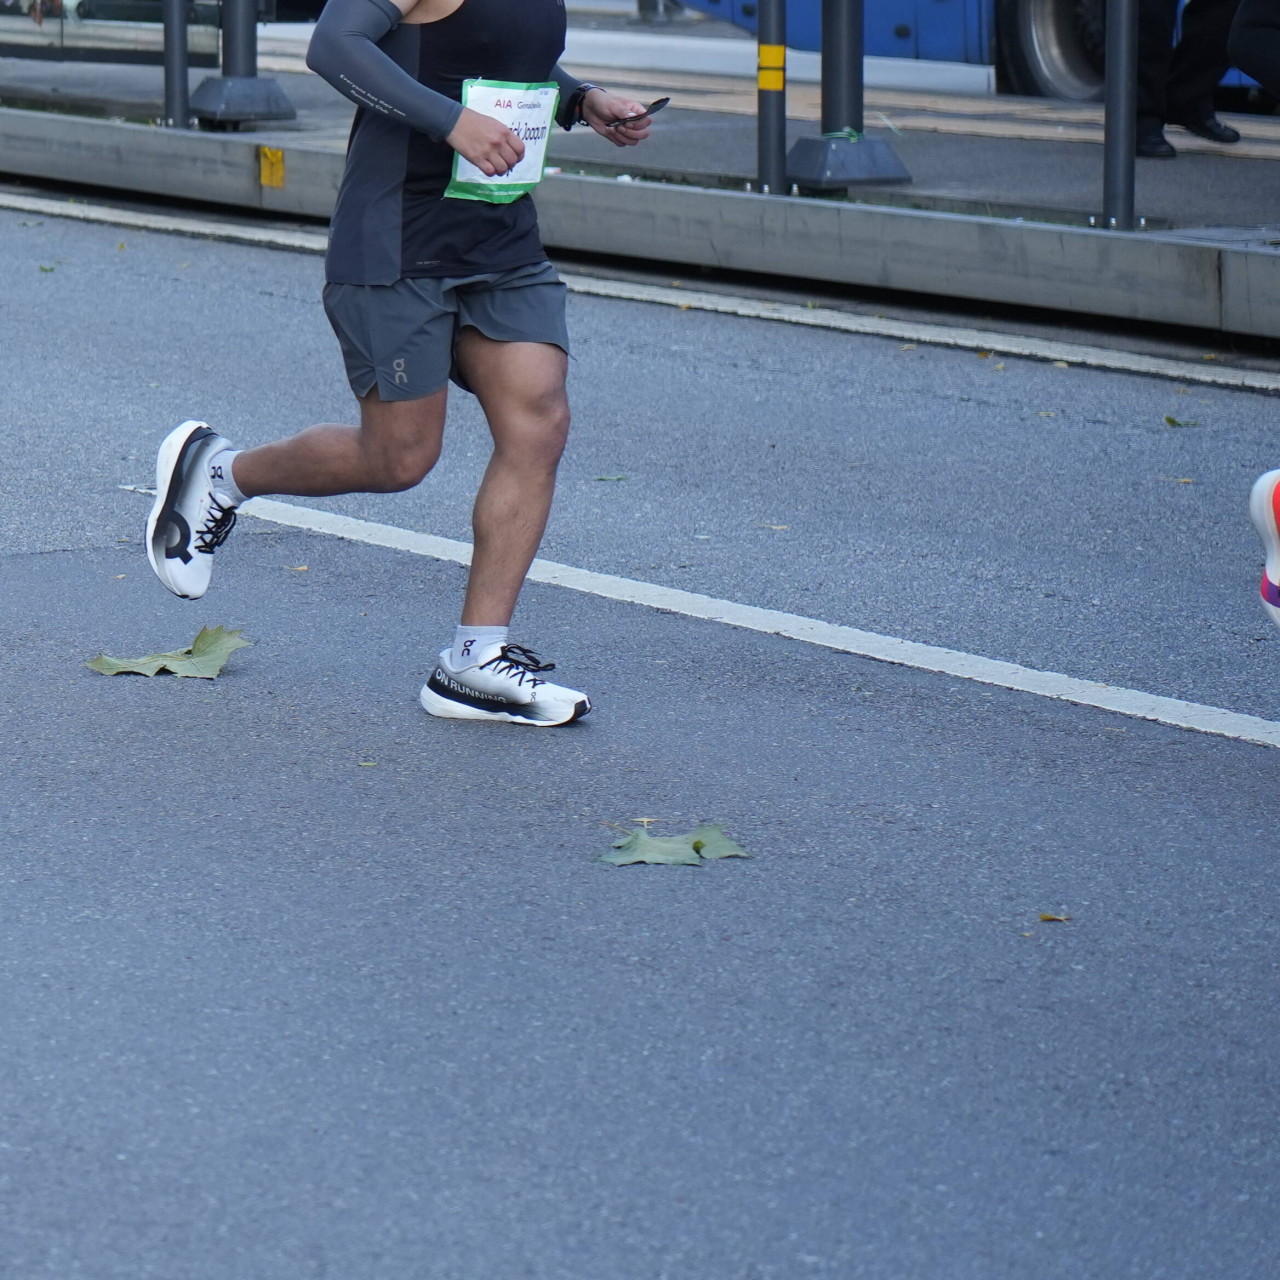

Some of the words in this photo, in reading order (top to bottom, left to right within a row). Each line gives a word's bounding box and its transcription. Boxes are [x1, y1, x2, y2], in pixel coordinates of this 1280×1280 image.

[495, 100, 512, 109] AIA
[436, 668, 449, 686] ON
[450, 679, 507, 704] RUNNING
